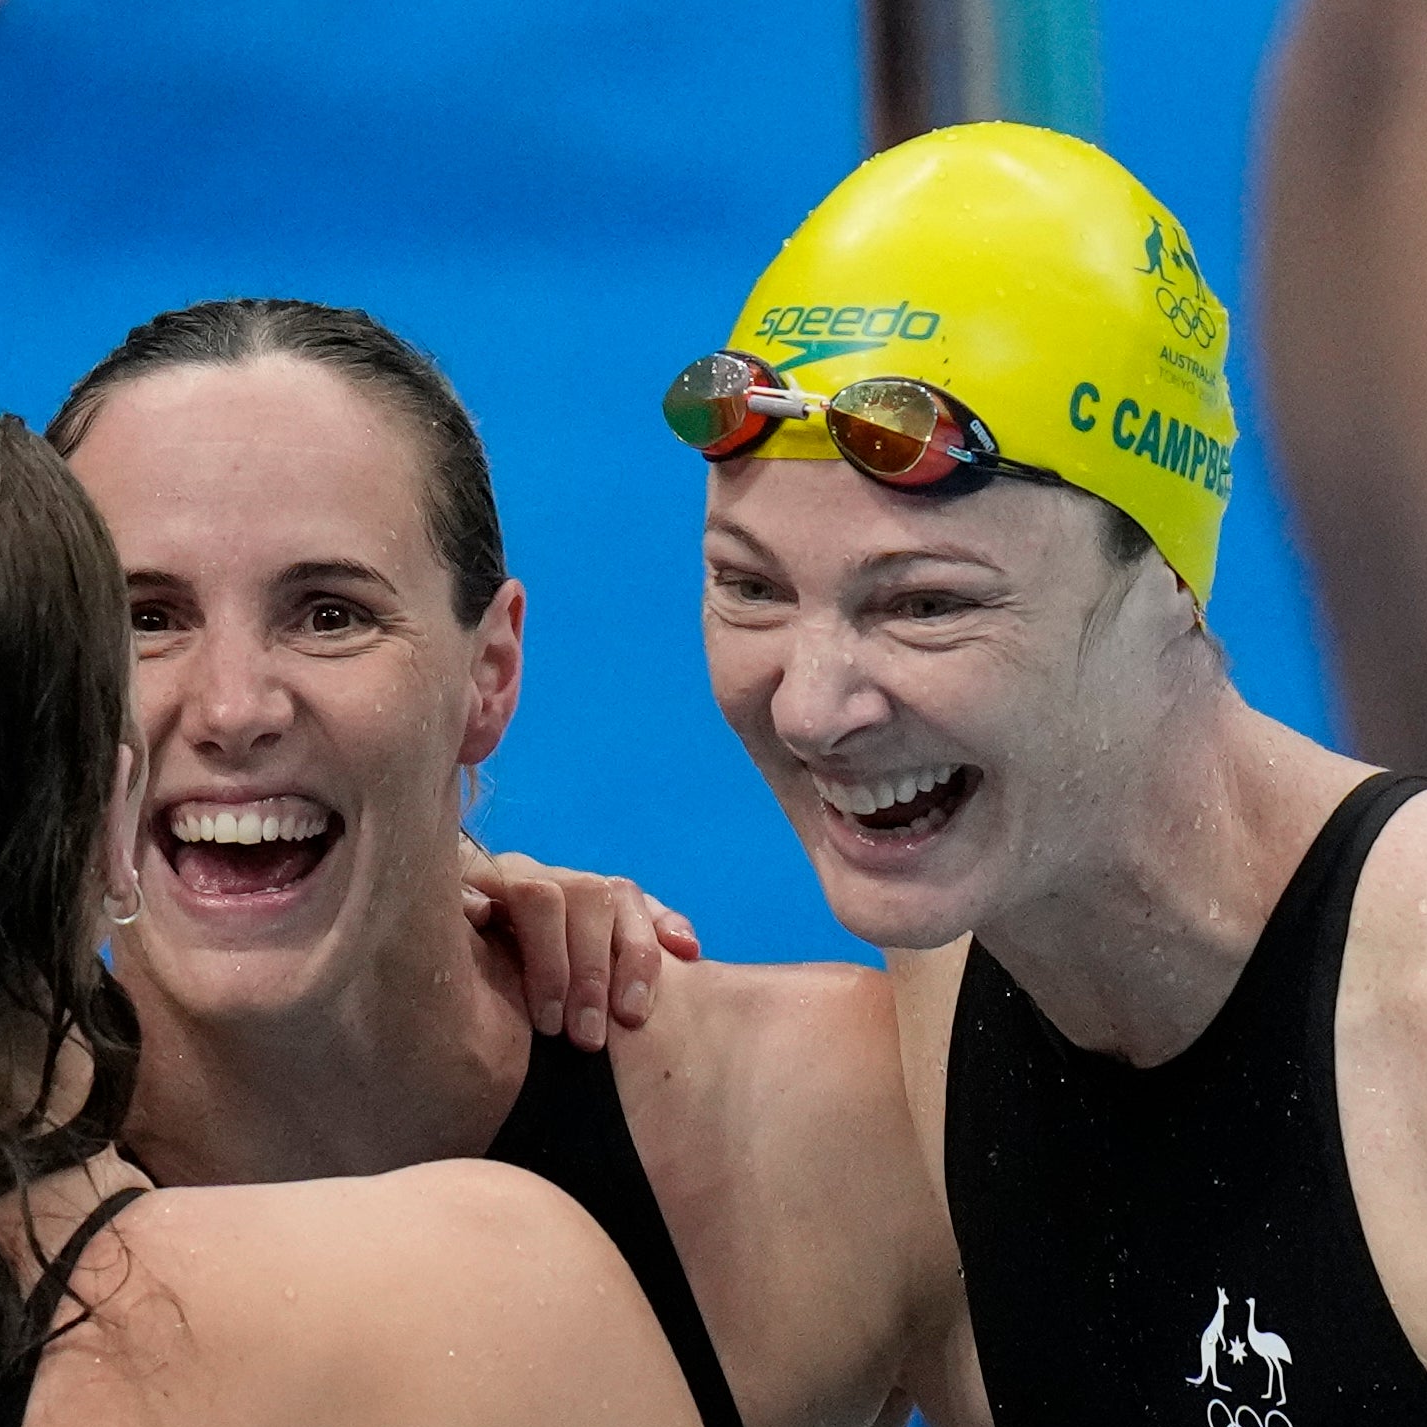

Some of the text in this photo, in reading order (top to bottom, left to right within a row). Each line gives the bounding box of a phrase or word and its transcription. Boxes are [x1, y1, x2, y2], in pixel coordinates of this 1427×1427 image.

[755, 301, 940, 345] speedo
[1069, 381, 1231, 499] C CAMPBE
